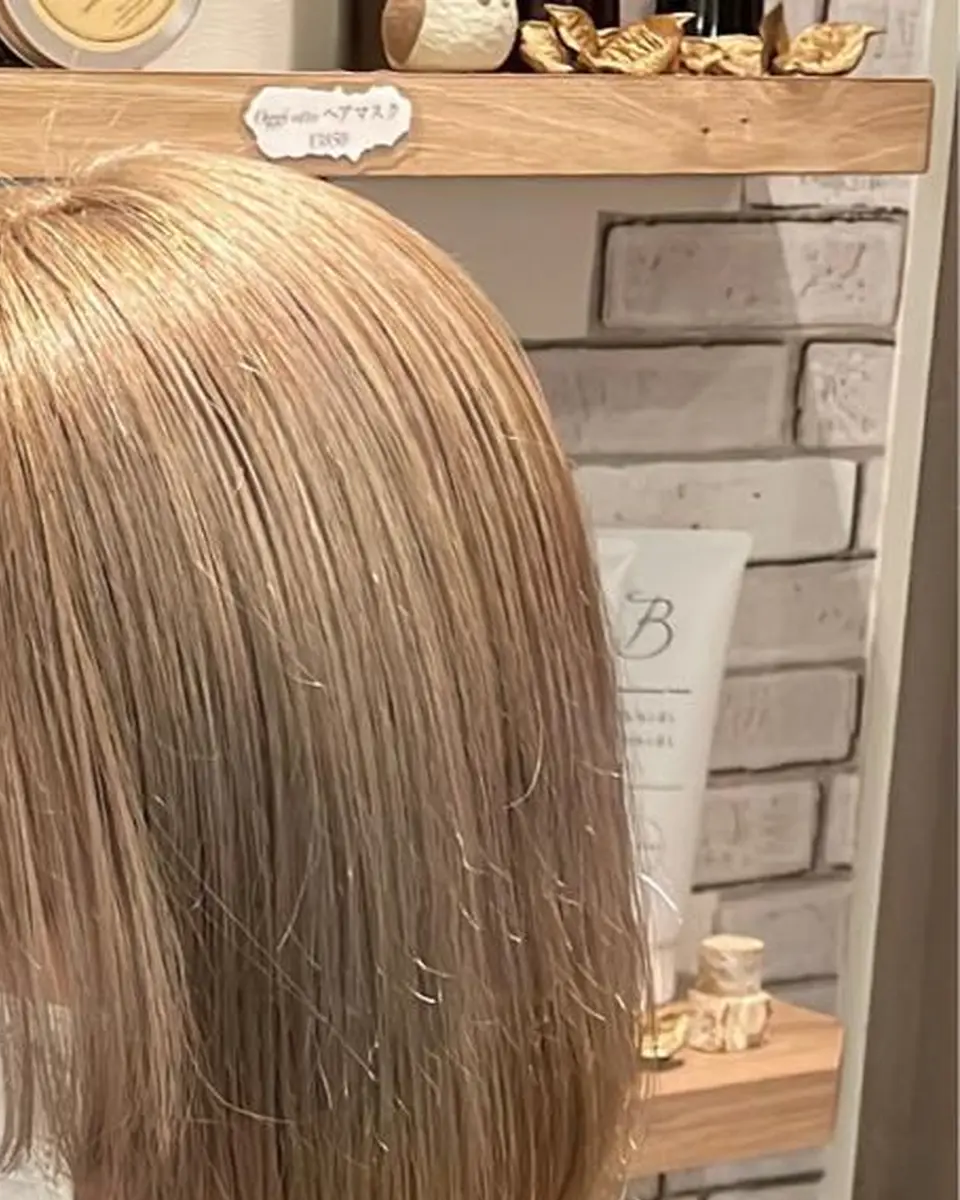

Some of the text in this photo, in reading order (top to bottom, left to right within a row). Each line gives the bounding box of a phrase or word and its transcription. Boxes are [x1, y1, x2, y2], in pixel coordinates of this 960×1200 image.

[323, 102, 400, 121] ヘアマスク
